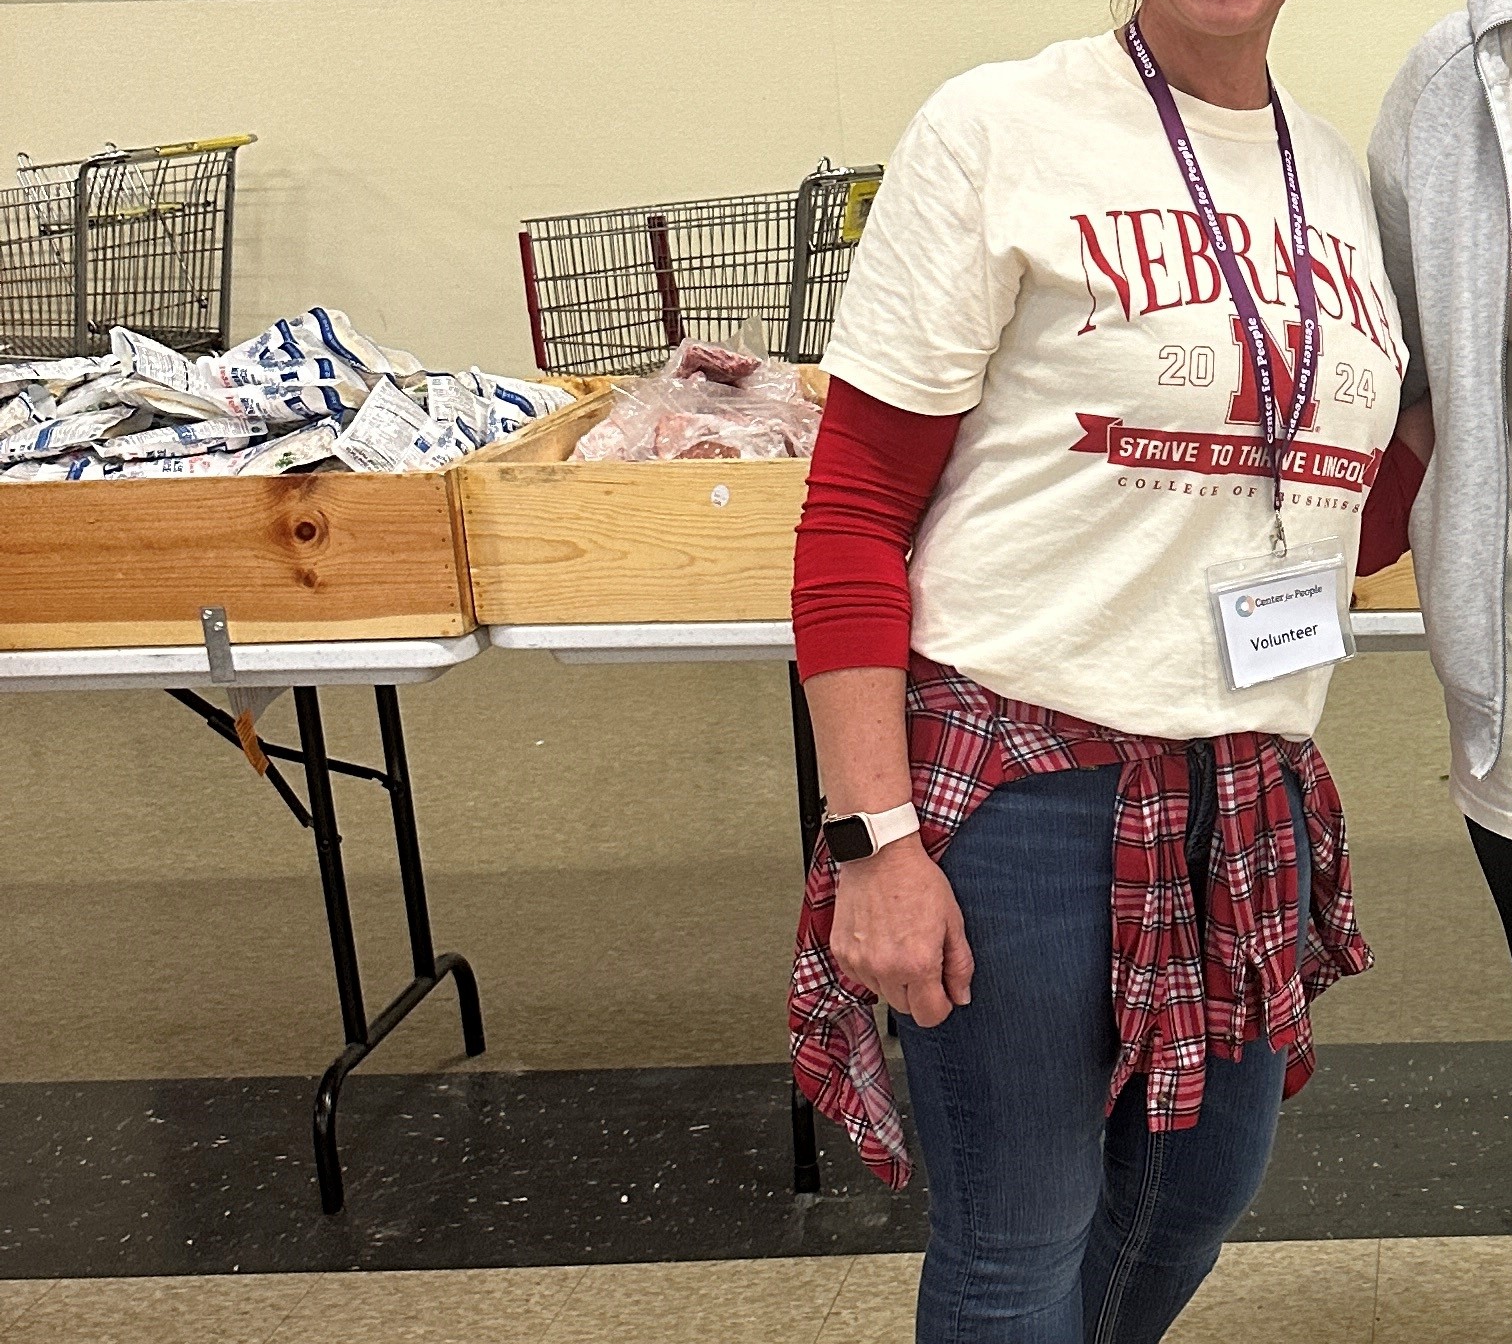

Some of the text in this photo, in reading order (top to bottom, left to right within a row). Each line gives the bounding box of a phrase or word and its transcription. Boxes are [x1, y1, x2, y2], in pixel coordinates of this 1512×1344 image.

[1178, 139, 1227, 252] Center for People
[1284, 150, 1306, 256] Center for People
[1158, 314, 1376, 432] 20 N 24
[1248, 318, 1273, 444] Center for People
[1287, 319, 1315, 441] Center for People
[1118, 476, 1361, 514] COLLEGE OF BUSINESS
[1119, 437, 1200, 463] STRIVE
[1210, 444, 1234, 467] TO
[1312, 453, 1365, 484] LINCOL
[1250, 624, 1319, 652] Volunteer
[1254, 584, 1323, 608] Center for People
